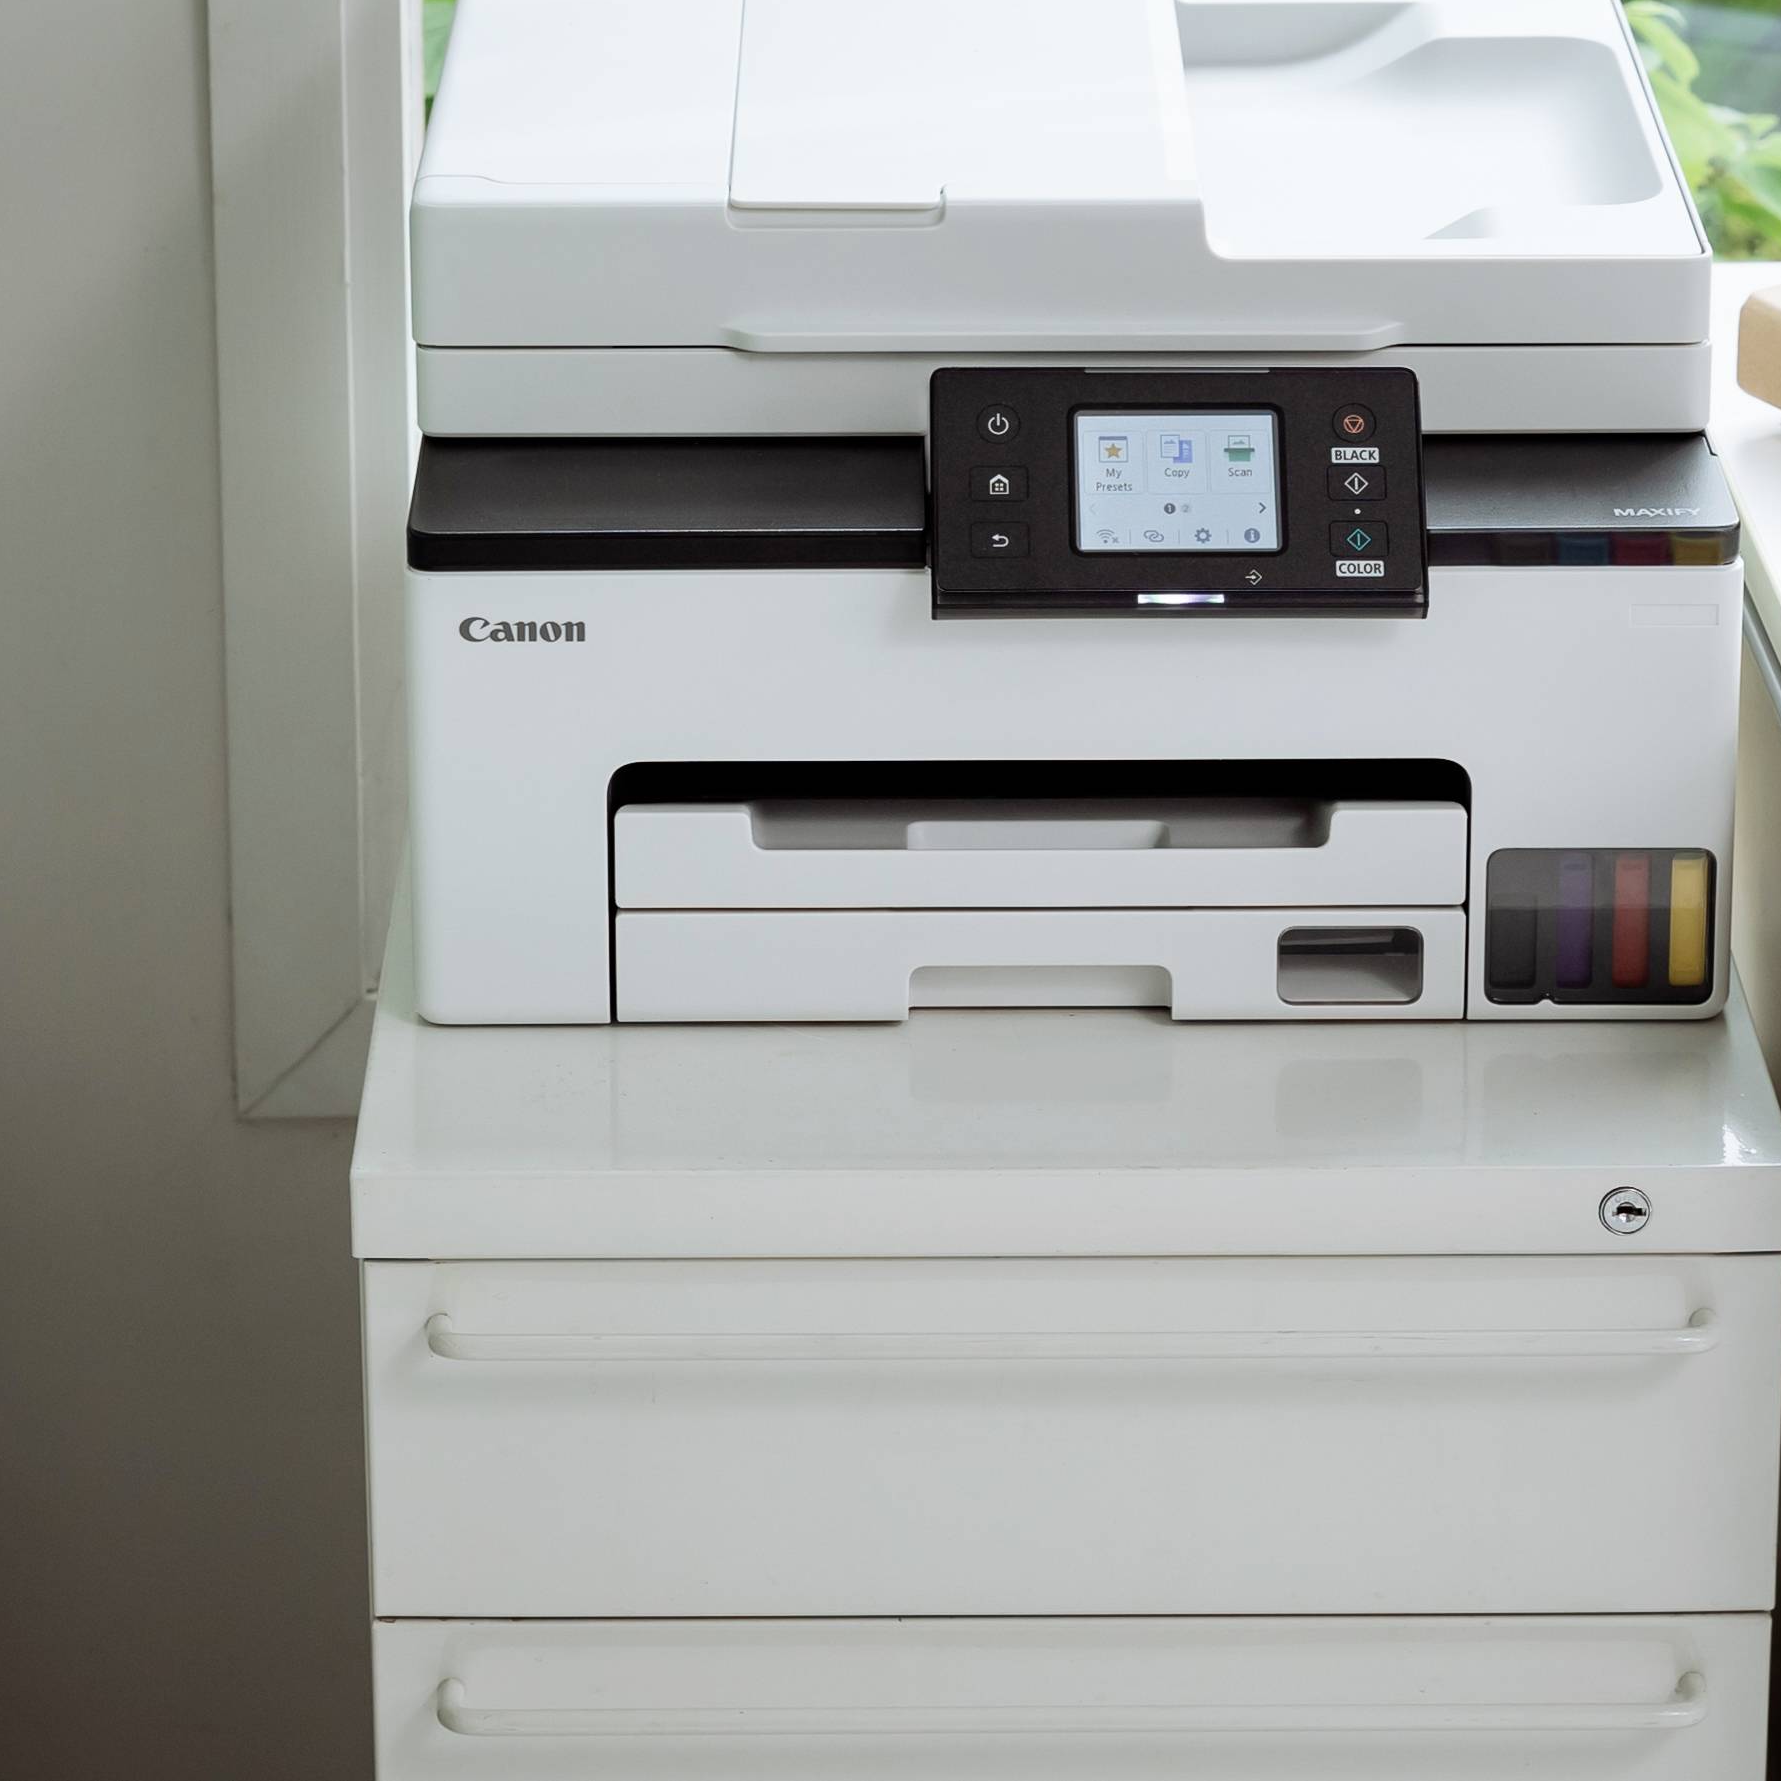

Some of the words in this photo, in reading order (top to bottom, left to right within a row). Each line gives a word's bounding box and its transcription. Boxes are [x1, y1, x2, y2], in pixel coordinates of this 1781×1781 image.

[1334, 449, 1377, 461] BLACK
[1106, 468, 1122, 479] My
[1164, 467, 1190, 479] Copy
[1228, 467, 1253, 477] Scan
[1095, 482, 1133, 492] Presets
[1613, 508, 1700, 517] MAXIFY
[1338, 563, 1382, 574] COLOR
[458, 616, 586, 643] Canon
